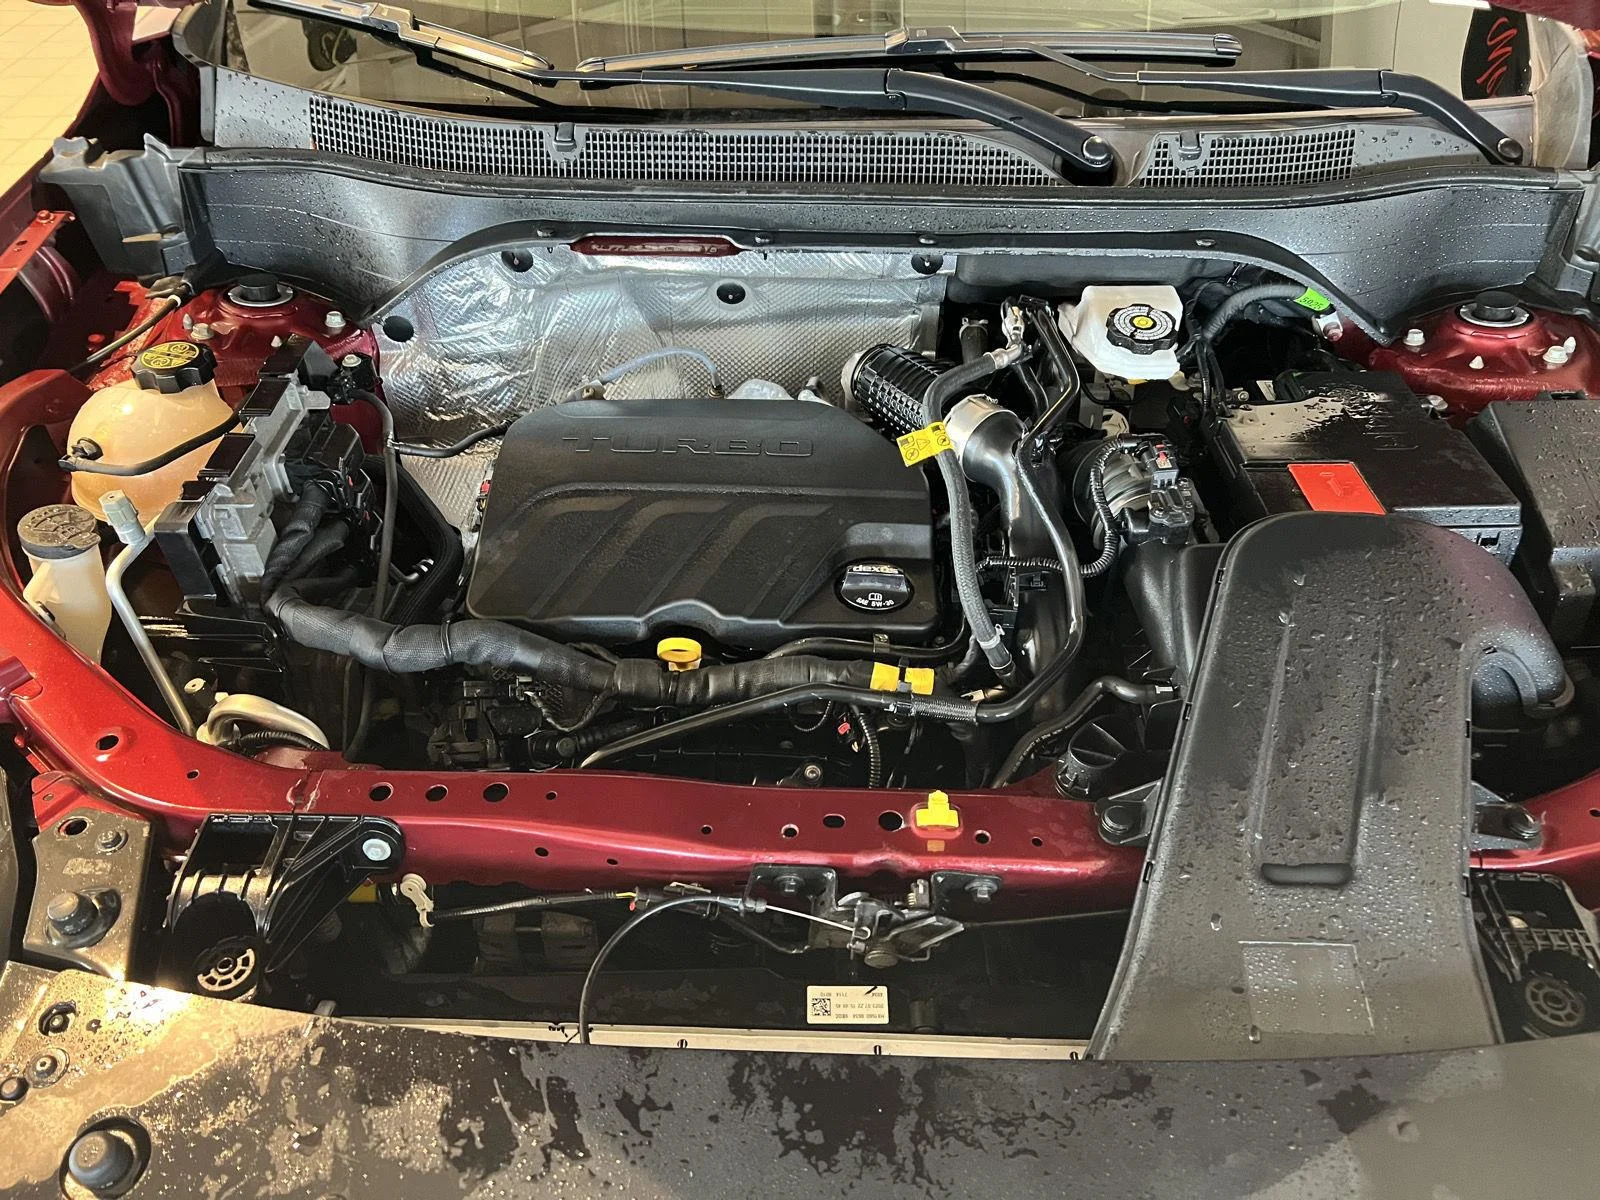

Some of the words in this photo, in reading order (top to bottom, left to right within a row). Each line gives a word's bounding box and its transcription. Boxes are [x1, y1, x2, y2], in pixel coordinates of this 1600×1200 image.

[562, 437, 813, 457] TURBO
[852, 565, 899, 574] dexos
[856, 597, 869, 605] SAE
[871, 599, 895, 607] 5W-30
